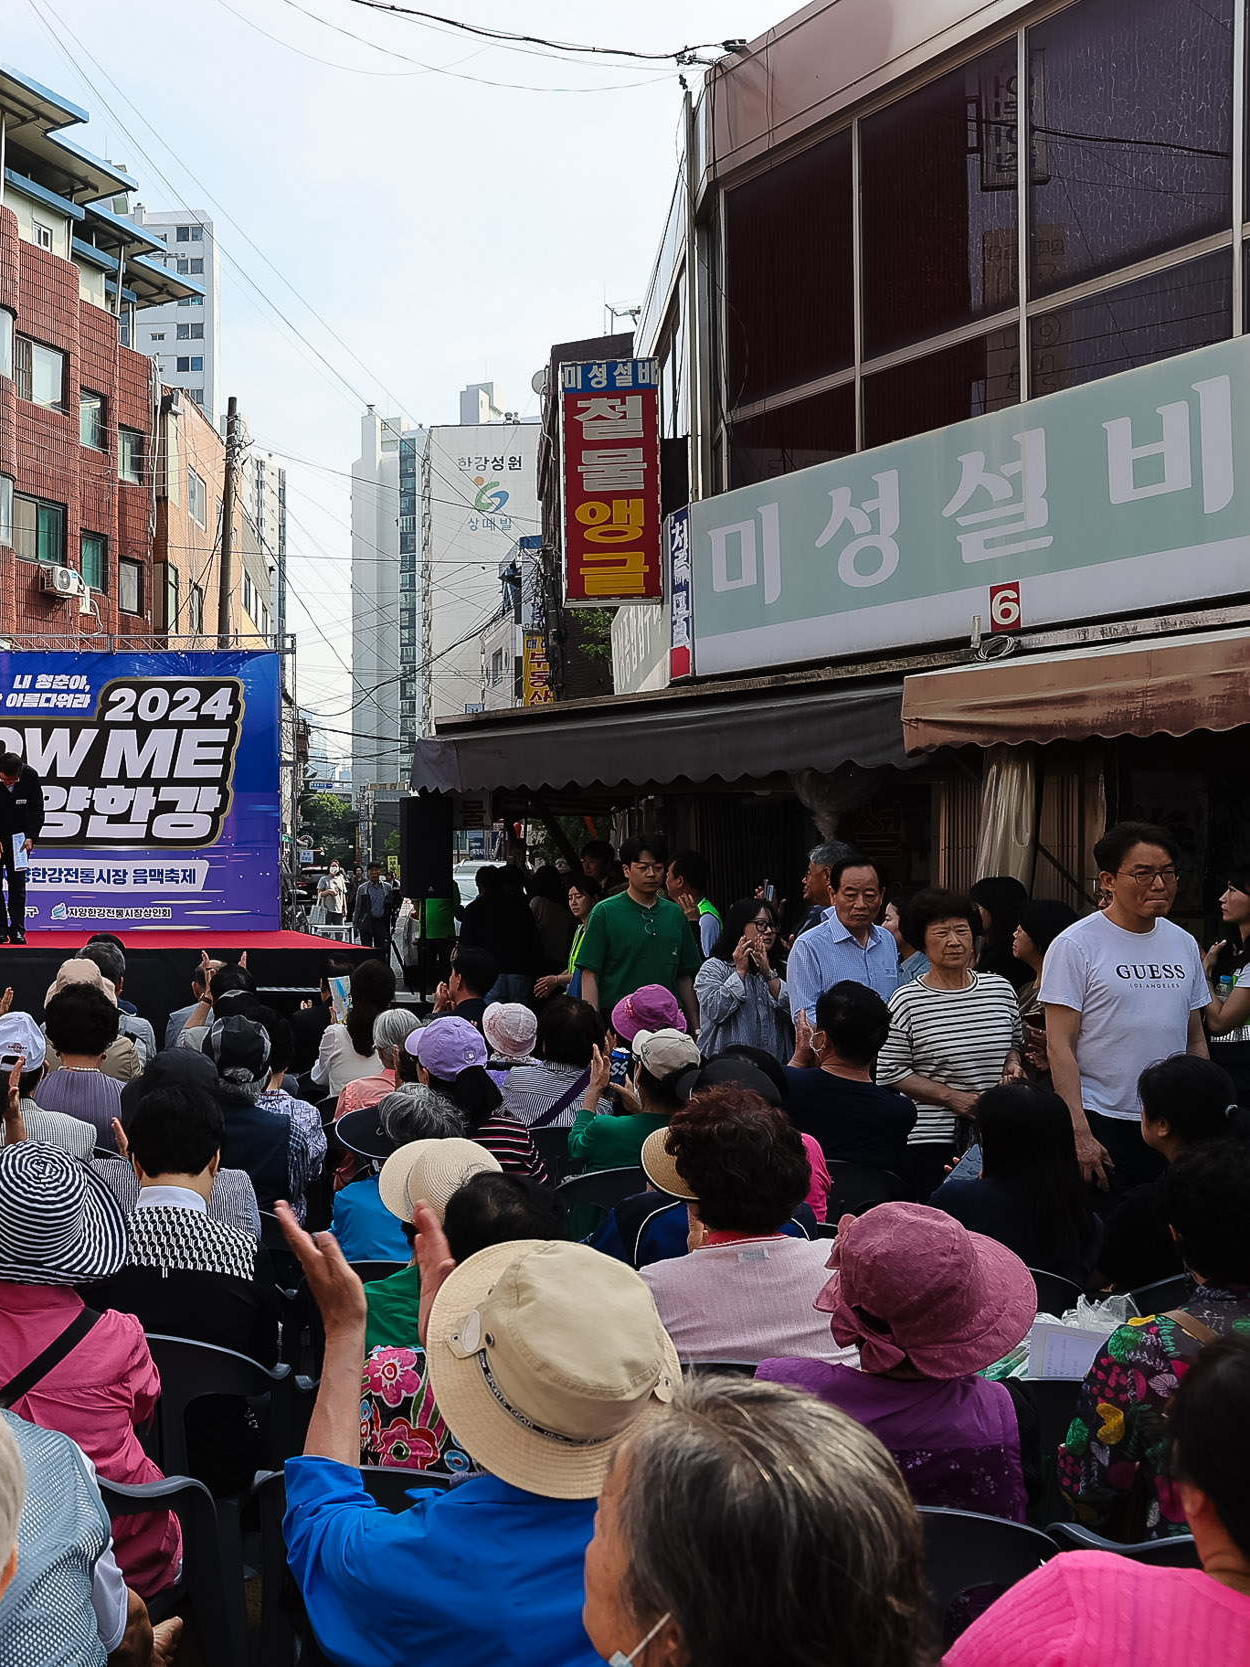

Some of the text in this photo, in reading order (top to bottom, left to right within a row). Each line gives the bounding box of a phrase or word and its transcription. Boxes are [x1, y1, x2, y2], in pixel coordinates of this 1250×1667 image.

[564, 362, 659, 389] 미성설비
[573, 395, 648, 492] 철물
[457, 455, 522, 471] 한강성원
[706, 374, 1234, 604] 미성설비
[575, 498, 650, 596] 앵글
[991, 589, 1020, 626] 6
[12, 674, 91, 693] 내 청춘아,
[529, 652, 554, 704] 부동산
[5, 692, 91, 709] 아름다워라
[103, 686, 234, 721] 2024
[100, 728, 231, 779] ME
[131, 867, 198, 886] 음맥축제
[1116, 963, 1186, 980] GUESS
